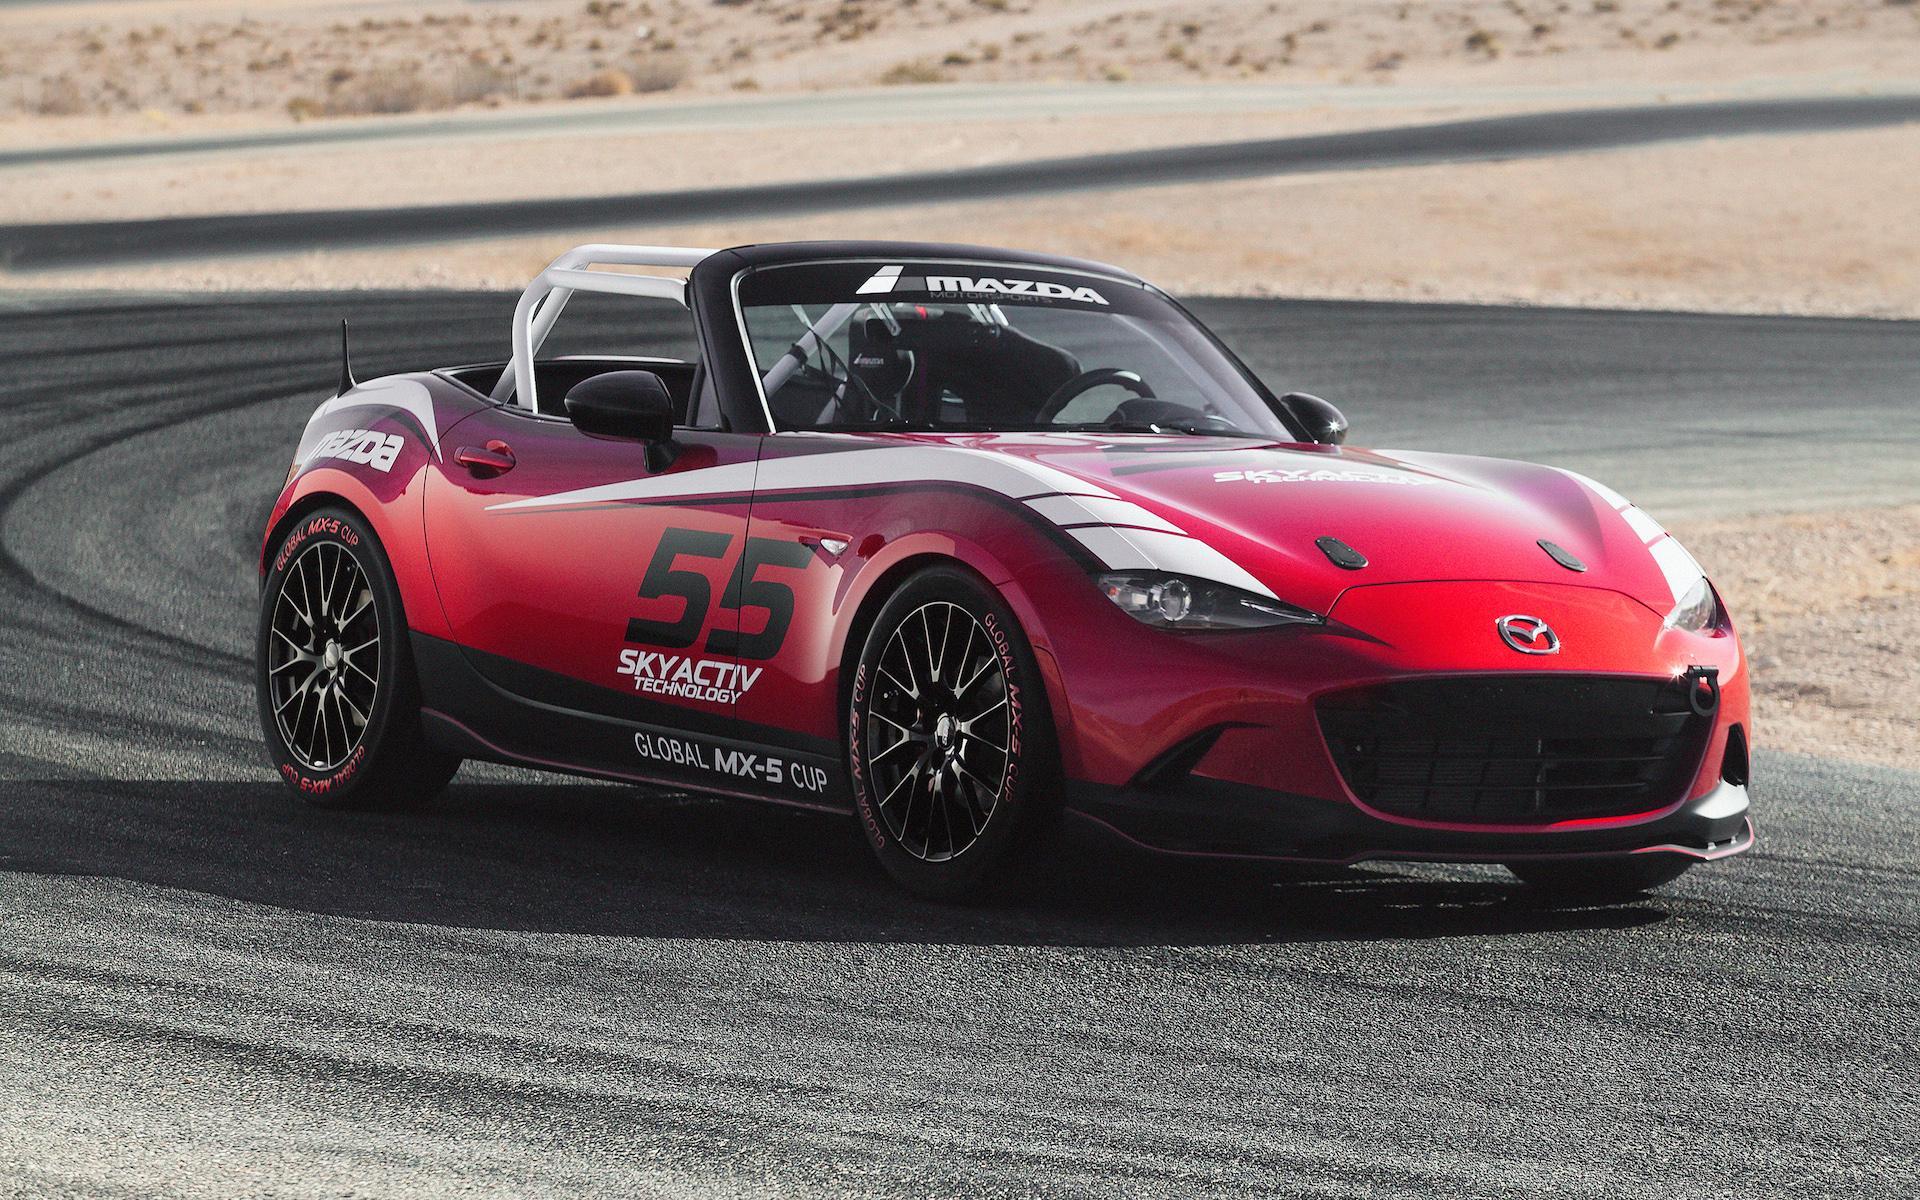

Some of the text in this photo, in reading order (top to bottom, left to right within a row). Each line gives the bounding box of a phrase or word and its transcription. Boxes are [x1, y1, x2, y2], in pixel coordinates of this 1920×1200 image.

[926, 276, 1110, 306] MAZDA
[276, 517, 359, 571] GLOBAL MX-5 CUP
[624, 526, 812, 661] 55
[616, 648, 763, 693] SKYACTIV
[633, 675, 743, 705] TECHNOLOGY
[984, 612, 1023, 802] GLOBAL MX-5 CUP
[281, 744, 365, 795] GLOBAL MX-5 CUP
[634, 731, 828, 793] GLOBAL MX-5 CUP
[851, 663, 886, 849] GLOBAL MX-5 CUP
